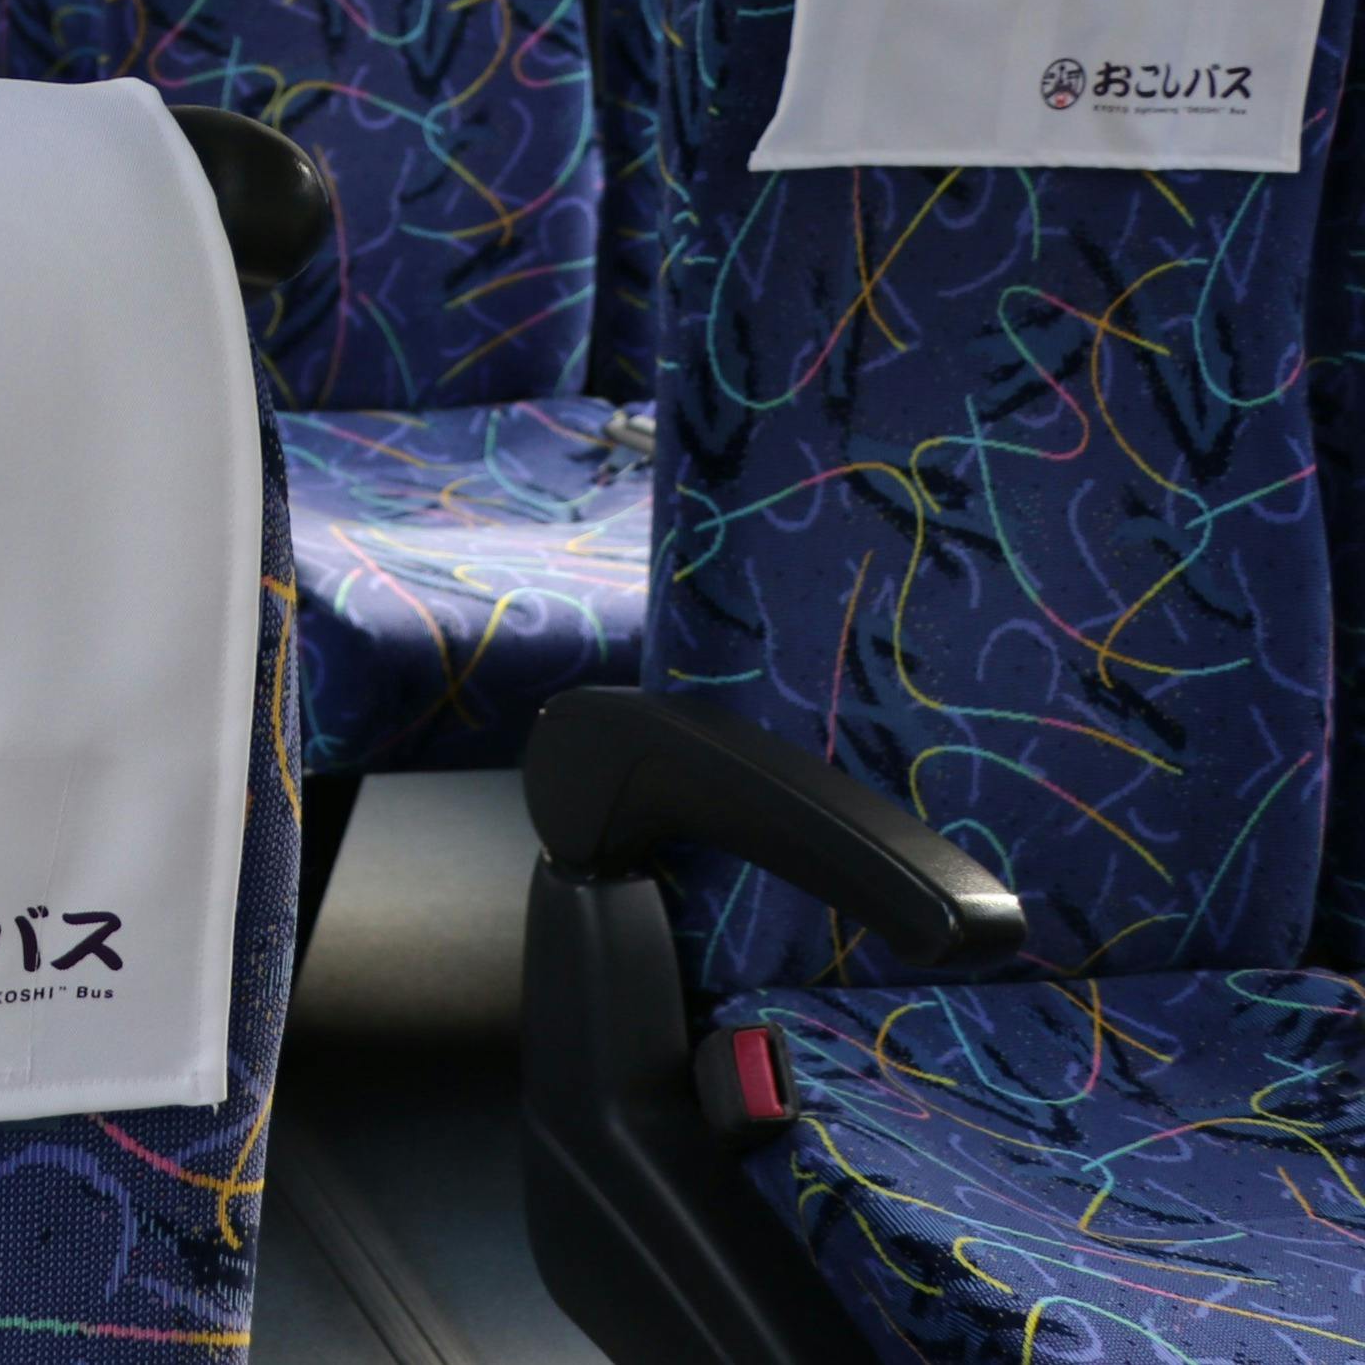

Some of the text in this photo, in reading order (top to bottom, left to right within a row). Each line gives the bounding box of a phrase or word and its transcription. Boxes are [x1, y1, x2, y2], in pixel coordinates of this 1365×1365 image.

[1092, 61, 1252, 99] おこしバス
[76, 985, 115, 1000] Bus
